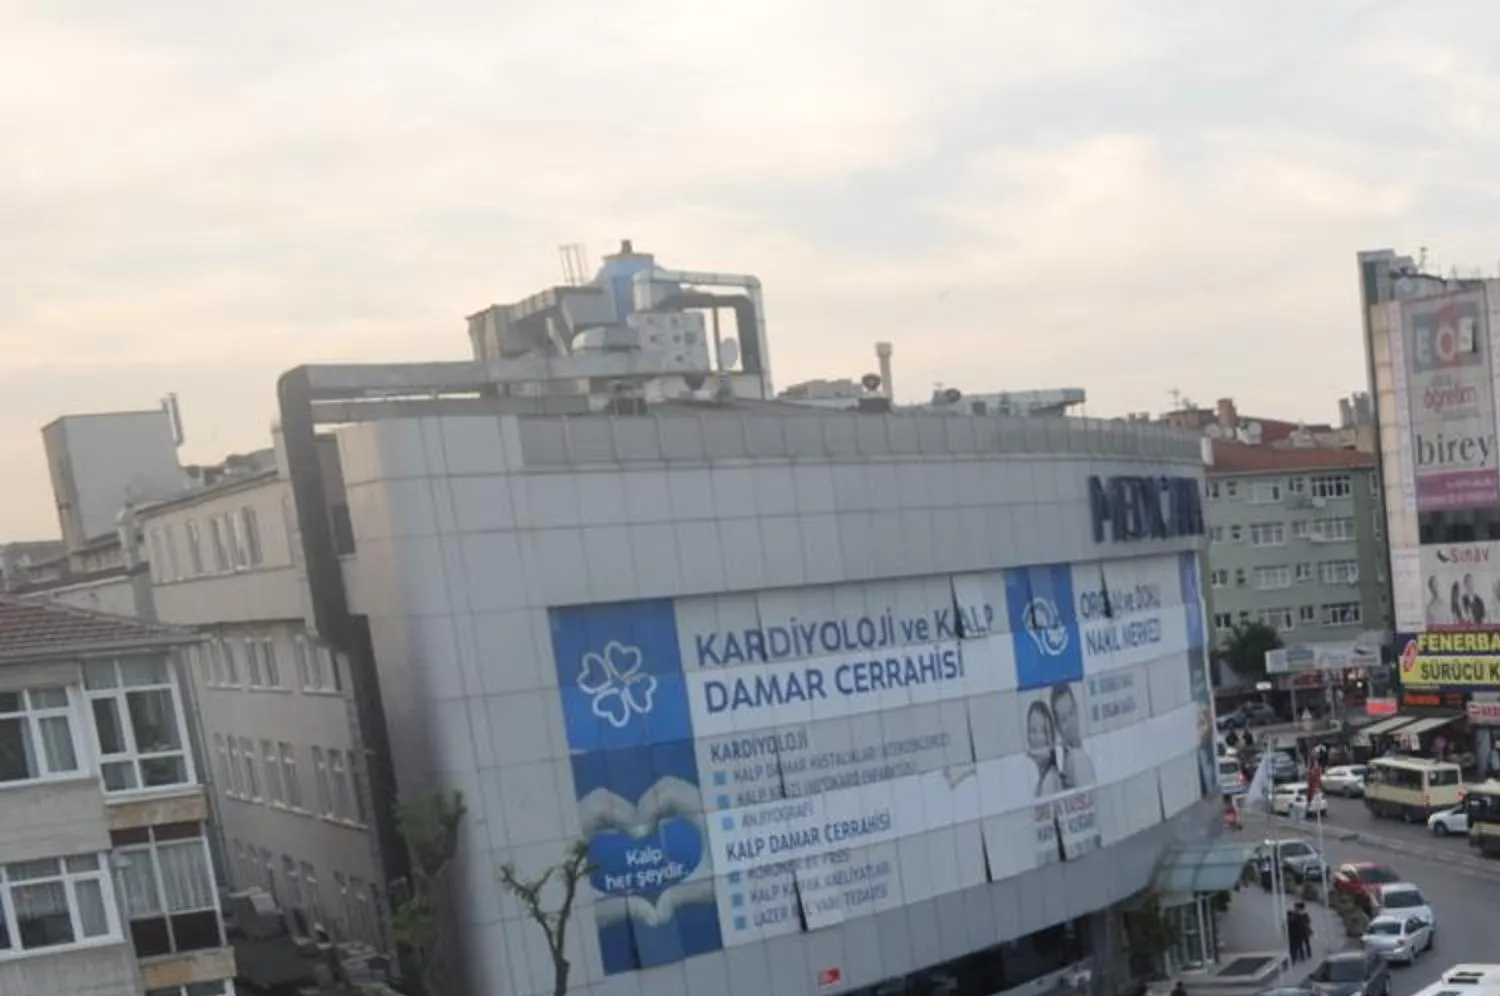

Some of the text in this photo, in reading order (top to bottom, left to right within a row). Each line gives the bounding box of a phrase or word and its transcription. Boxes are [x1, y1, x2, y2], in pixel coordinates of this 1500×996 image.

[1416, 432, 1495, 467] birey
[695, 606, 896, 668] KARDİYOLOJİ
[901, 615, 928, 643] ve
[704, 640, 966, 714] DAMAR CERRAHİSİ
[1420, 657, 1485, 682] SÜRÜCÜ
[709, 729, 809, 764] KARDİYOLOJİ
[726, 808, 893, 863] KALP DAMAR CERRAHİSİ
[625, 847, 664, 868] Kalp
[603, 870, 633, 891] her
